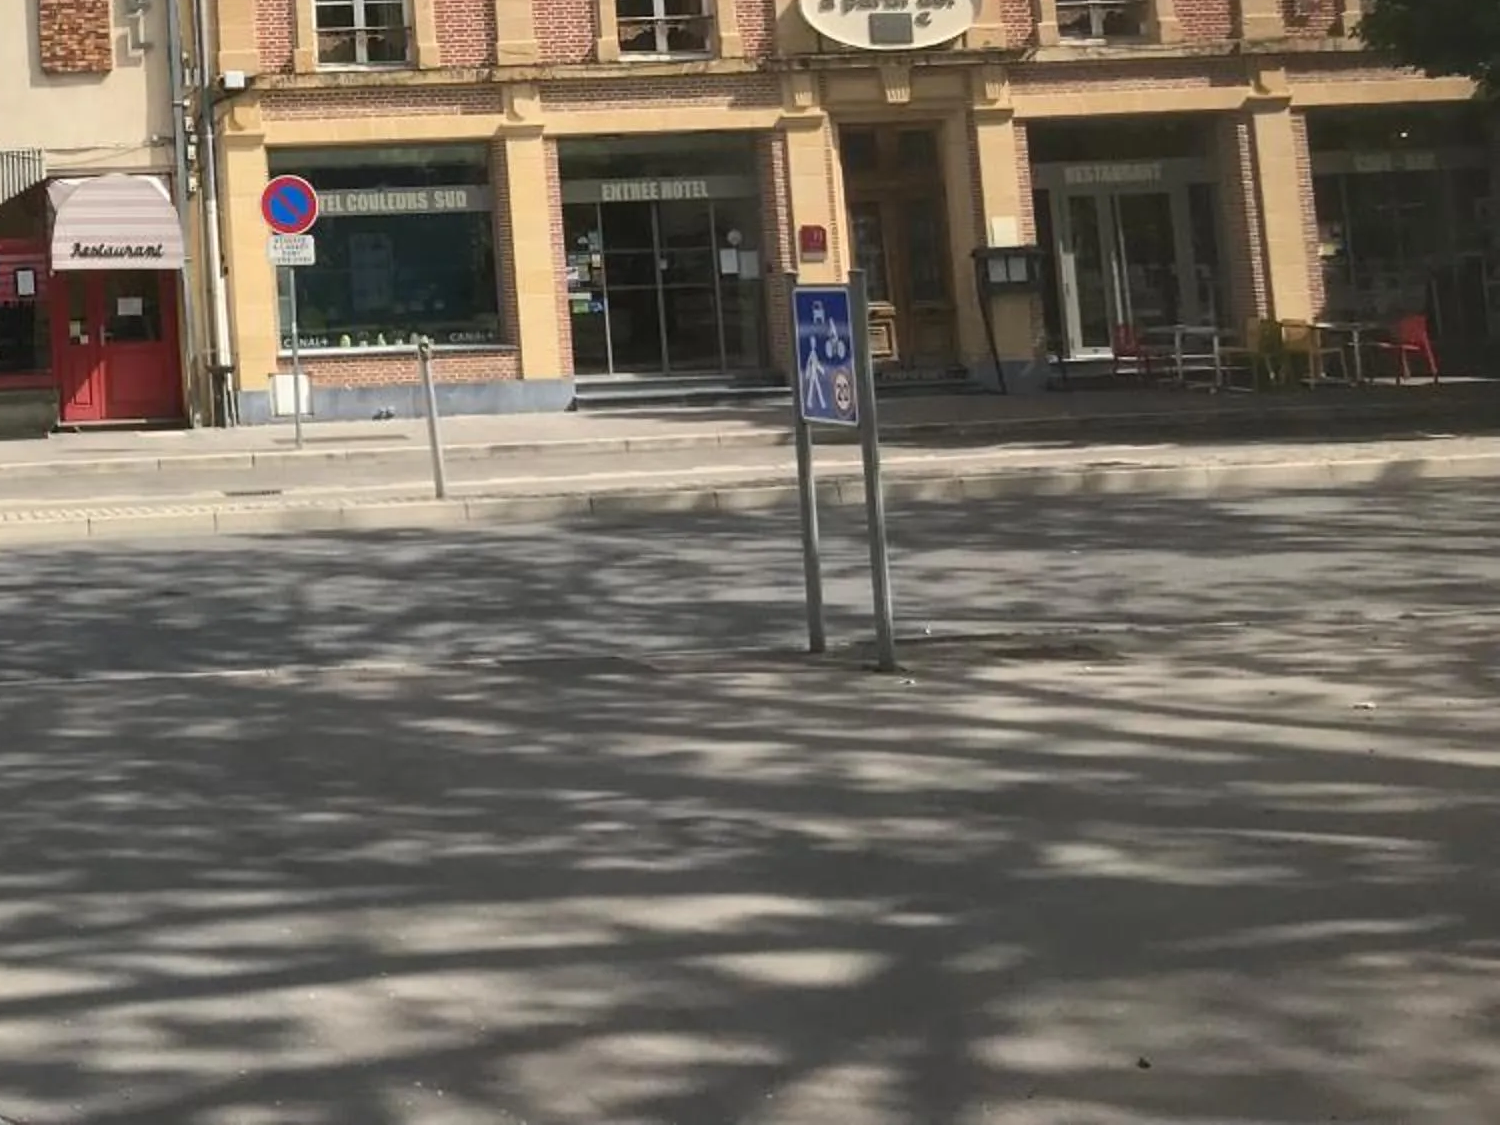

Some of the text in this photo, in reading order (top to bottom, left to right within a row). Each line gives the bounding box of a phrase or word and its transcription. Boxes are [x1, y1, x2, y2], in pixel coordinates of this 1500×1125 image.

[319, 190, 468, 212] TEL COULEURS SUD
[70, 242, 164, 259] Restaurant
